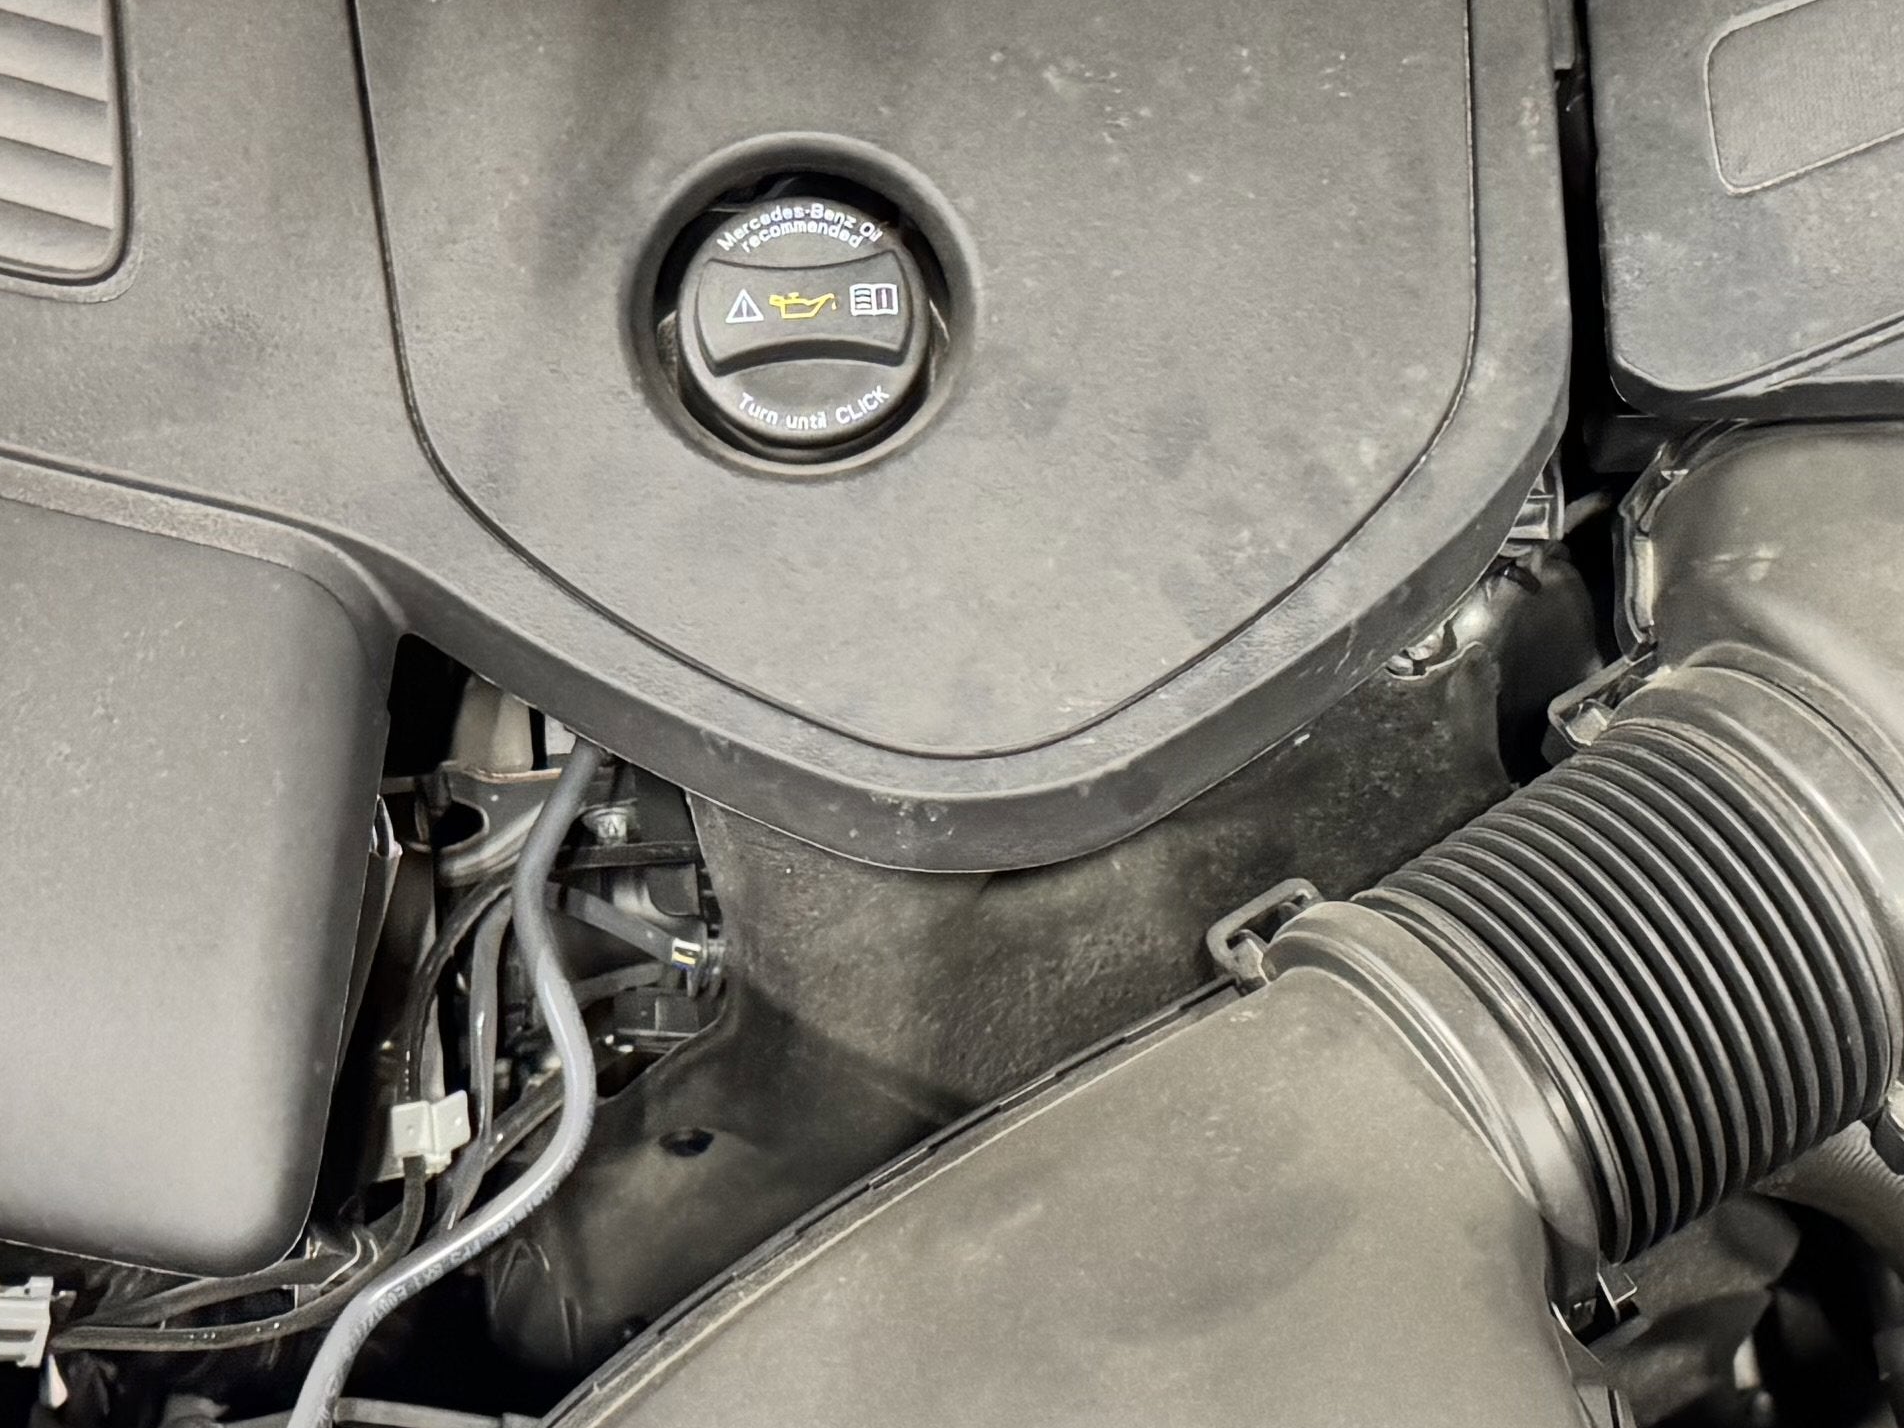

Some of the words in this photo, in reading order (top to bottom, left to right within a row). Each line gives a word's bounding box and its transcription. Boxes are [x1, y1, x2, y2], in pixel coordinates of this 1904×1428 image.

[716, 203, 857, 251] Mercedes-Benz
[862, 222, 883, 242] Oil
[742, 221, 859, 253] recommended
[737, 393, 780, 427] Turn
[785, 410, 828, 431] until
[834, 386, 891, 427] CLICK
